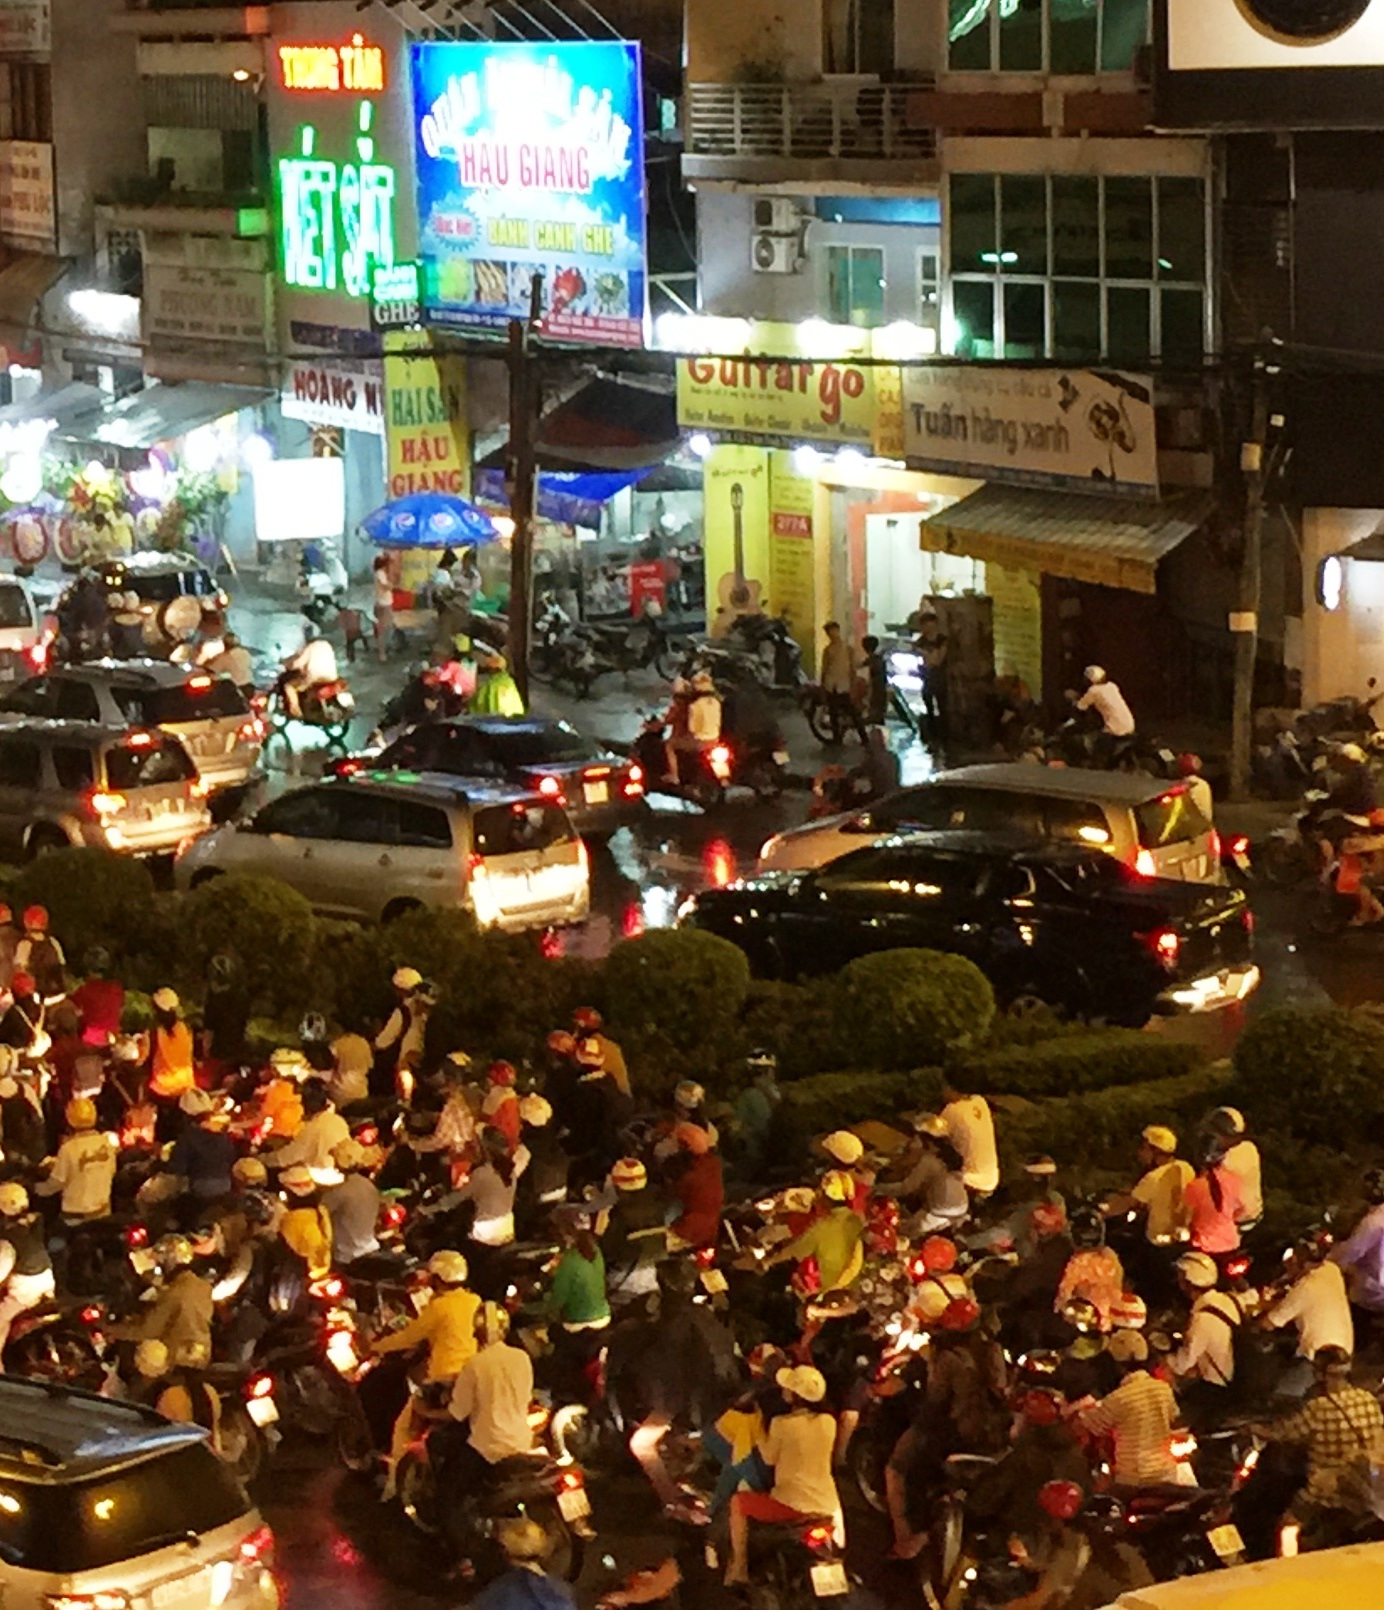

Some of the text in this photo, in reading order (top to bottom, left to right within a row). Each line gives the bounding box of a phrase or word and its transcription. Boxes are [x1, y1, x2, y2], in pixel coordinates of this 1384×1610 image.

[520, 143, 590, 190] GIANG
[373, 300, 420, 326] GHẸ
[391, 469, 463, 498] GIANG
